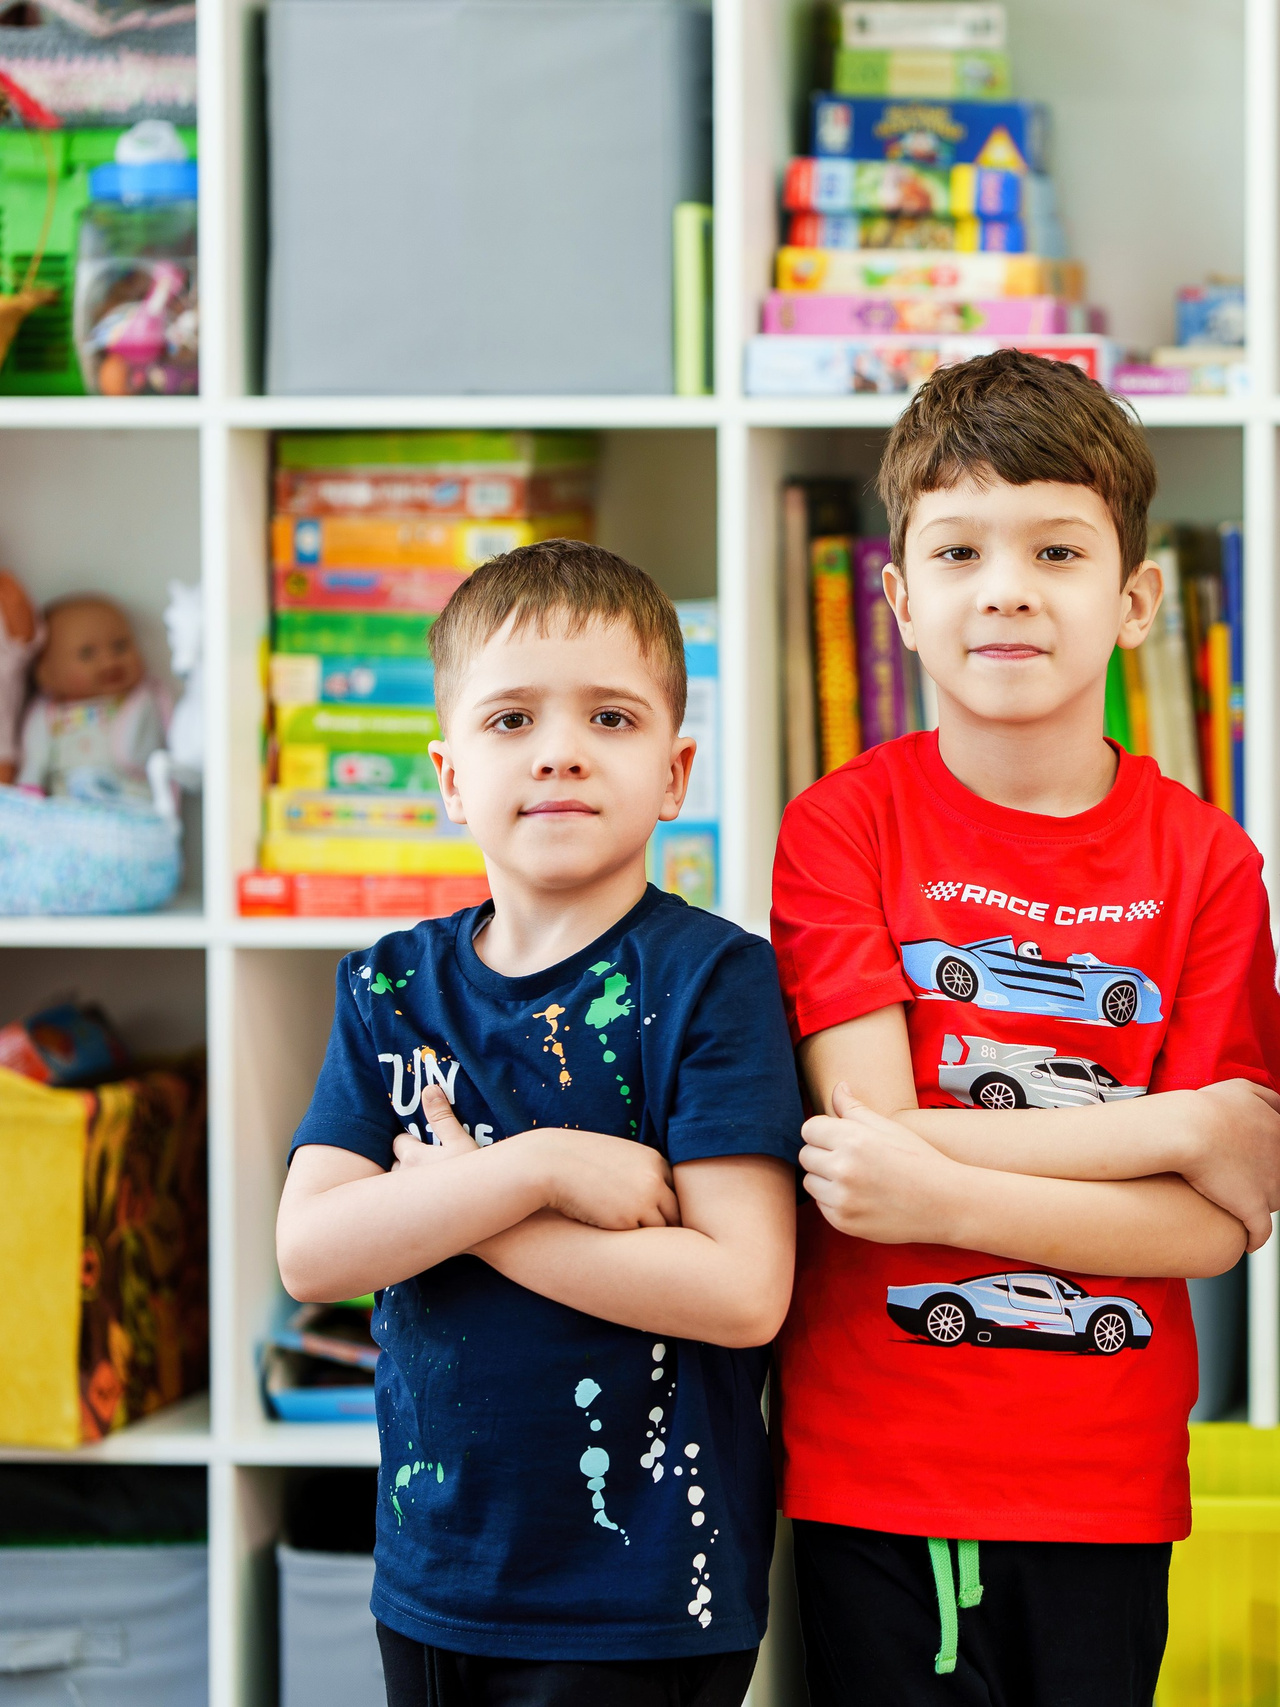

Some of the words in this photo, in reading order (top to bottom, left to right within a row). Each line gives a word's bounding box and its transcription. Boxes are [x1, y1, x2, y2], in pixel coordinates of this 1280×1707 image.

[961, 883, 1050, 922] RACE
[1054, 905, 1124, 926] CAR
[981, 1044, 997, 1060] 88
